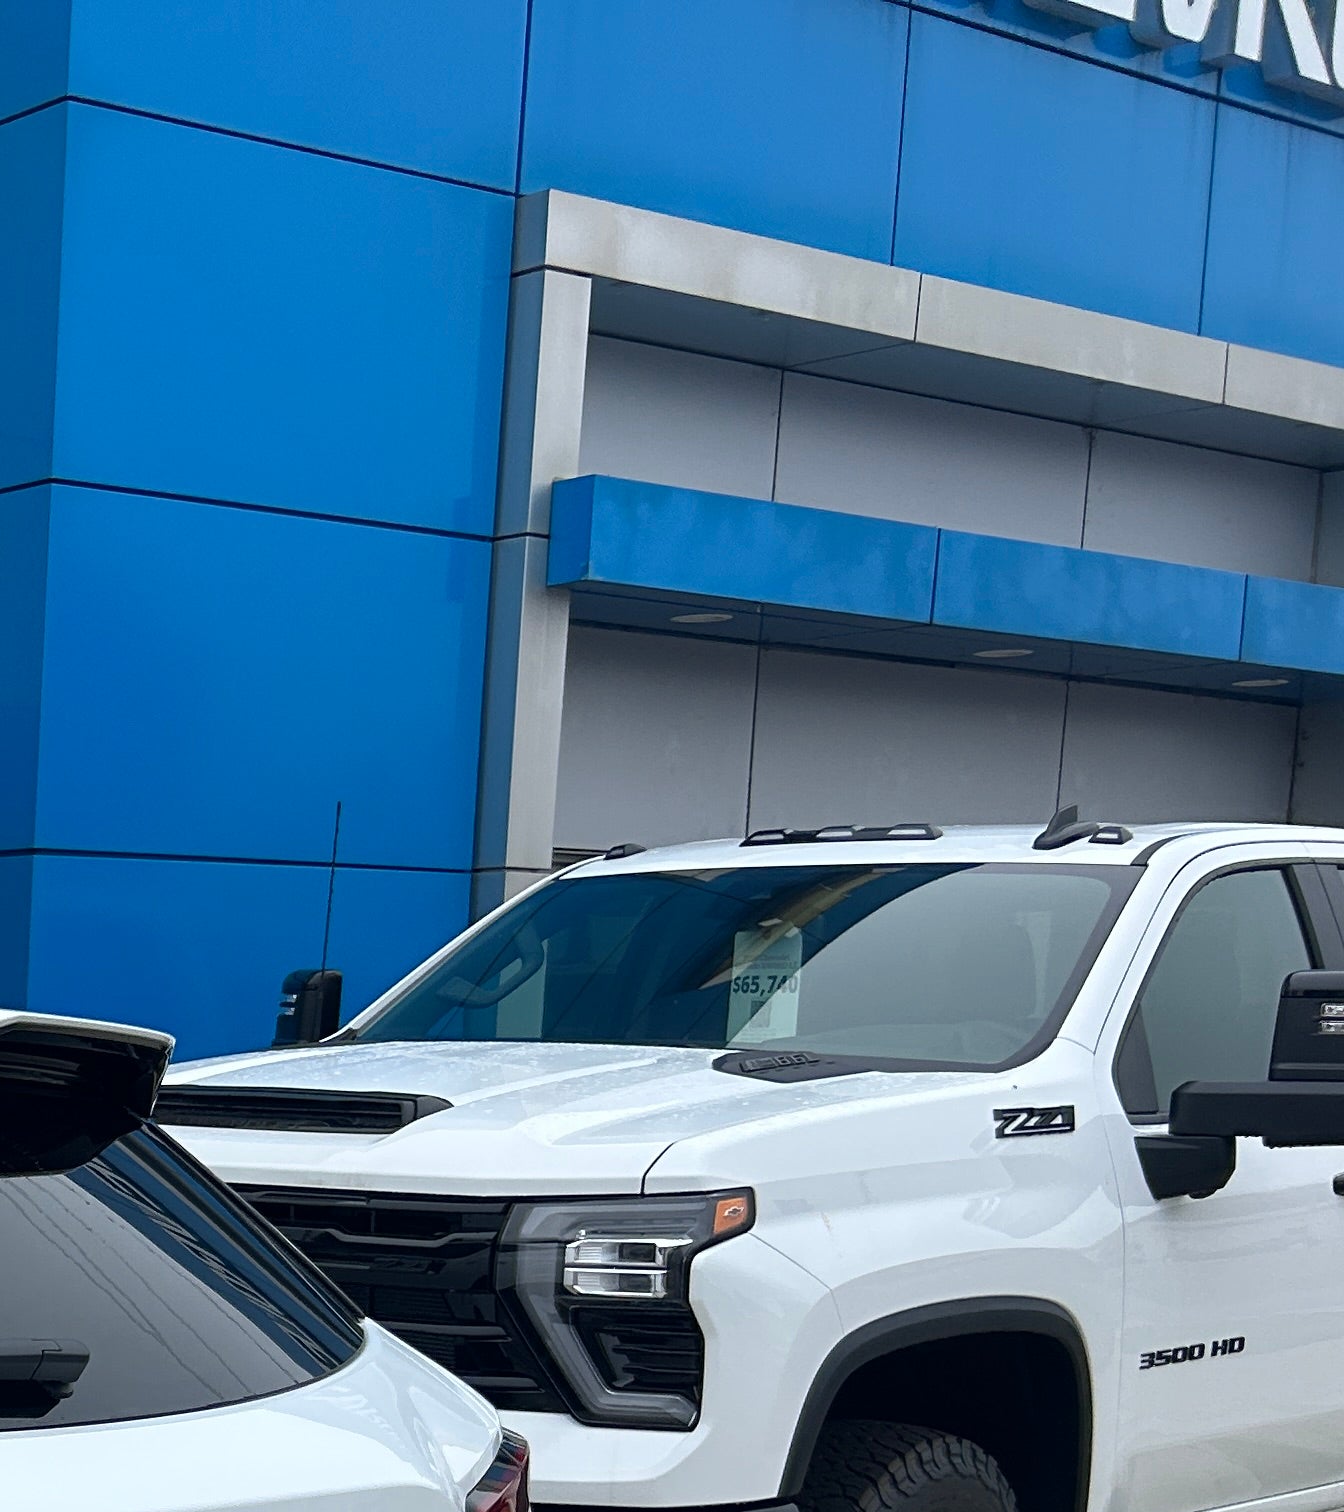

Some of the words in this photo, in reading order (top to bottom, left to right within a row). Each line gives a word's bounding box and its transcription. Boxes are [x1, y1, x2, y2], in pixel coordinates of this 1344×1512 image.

[731, 974, 799, 998] $65,740
[992, 1104, 1076, 1139] Z71
[1138, 1342, 1206, 1370] 3500
[1210, 1335, 1246, 1358] HD
